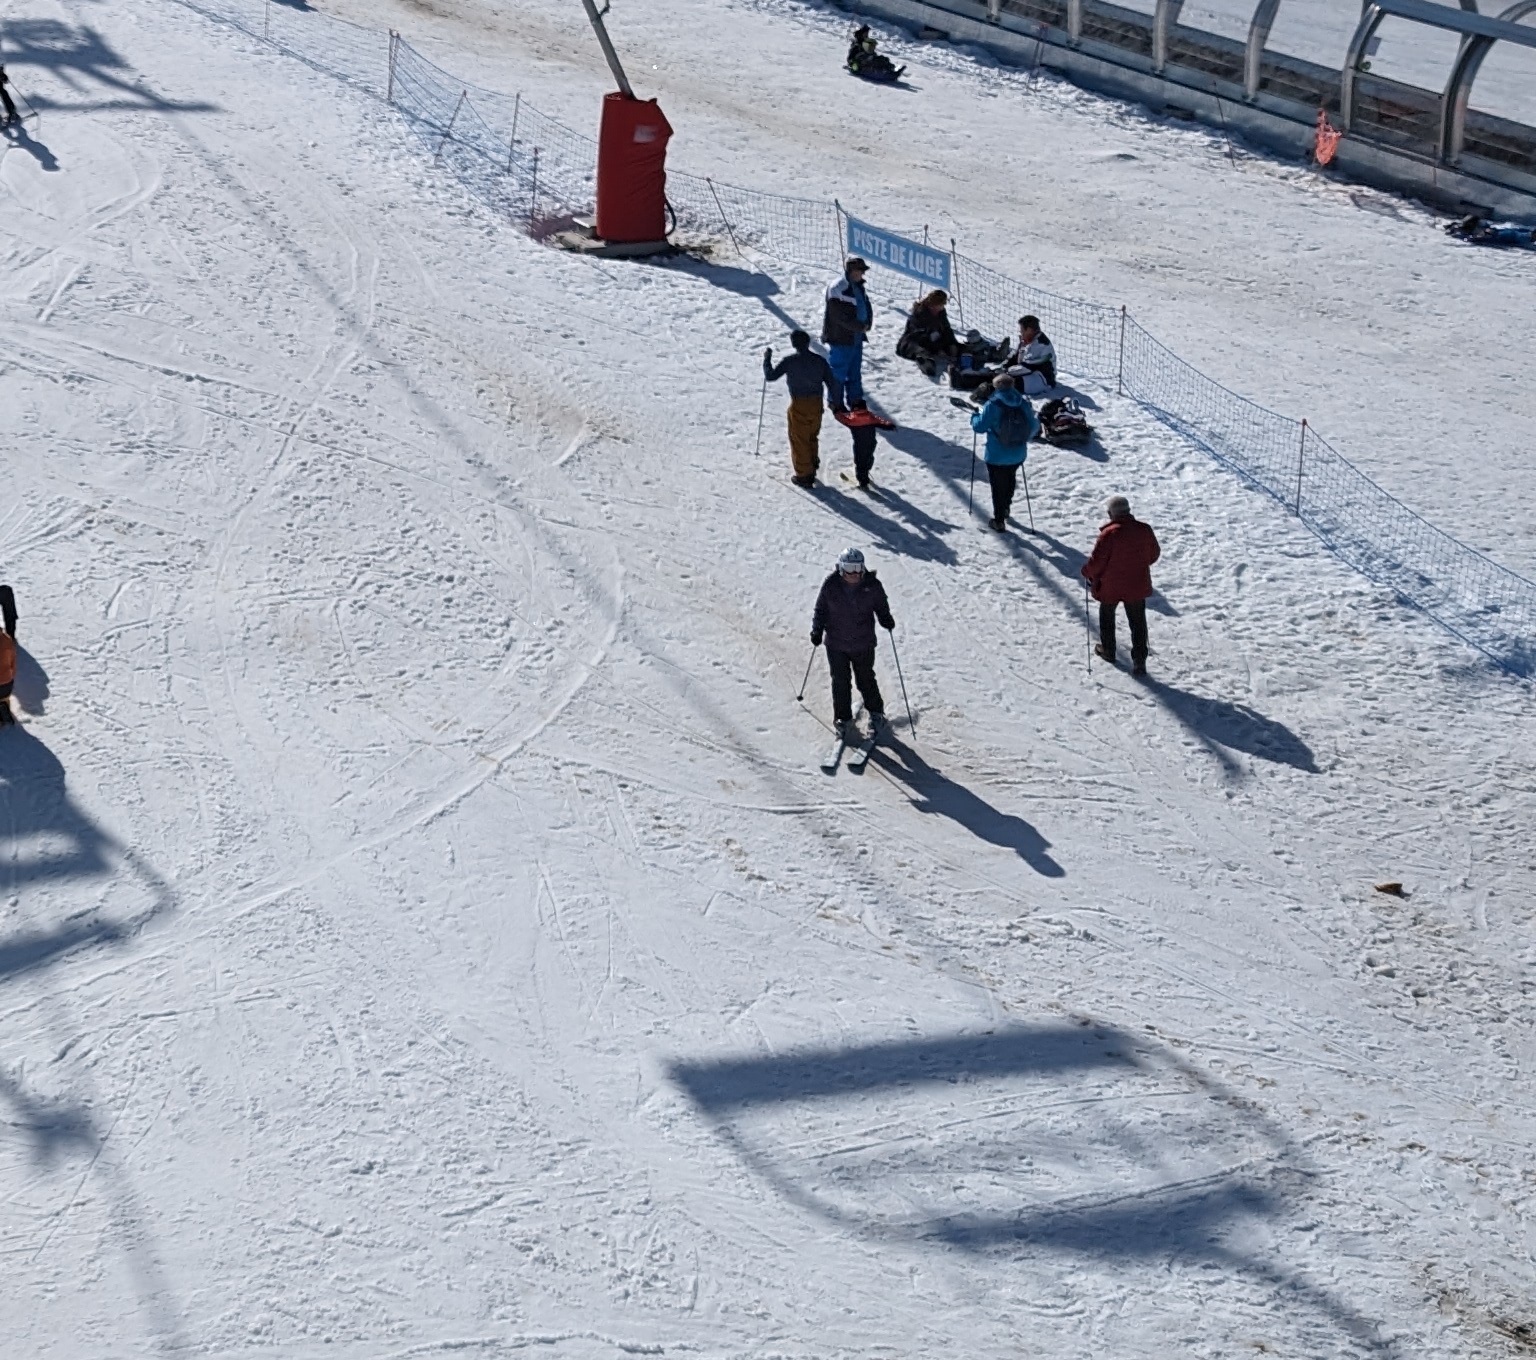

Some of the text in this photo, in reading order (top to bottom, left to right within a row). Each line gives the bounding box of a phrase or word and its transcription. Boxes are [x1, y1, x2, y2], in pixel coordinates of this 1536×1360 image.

[852, 227, 943, 280] PISTE DE LUGE
